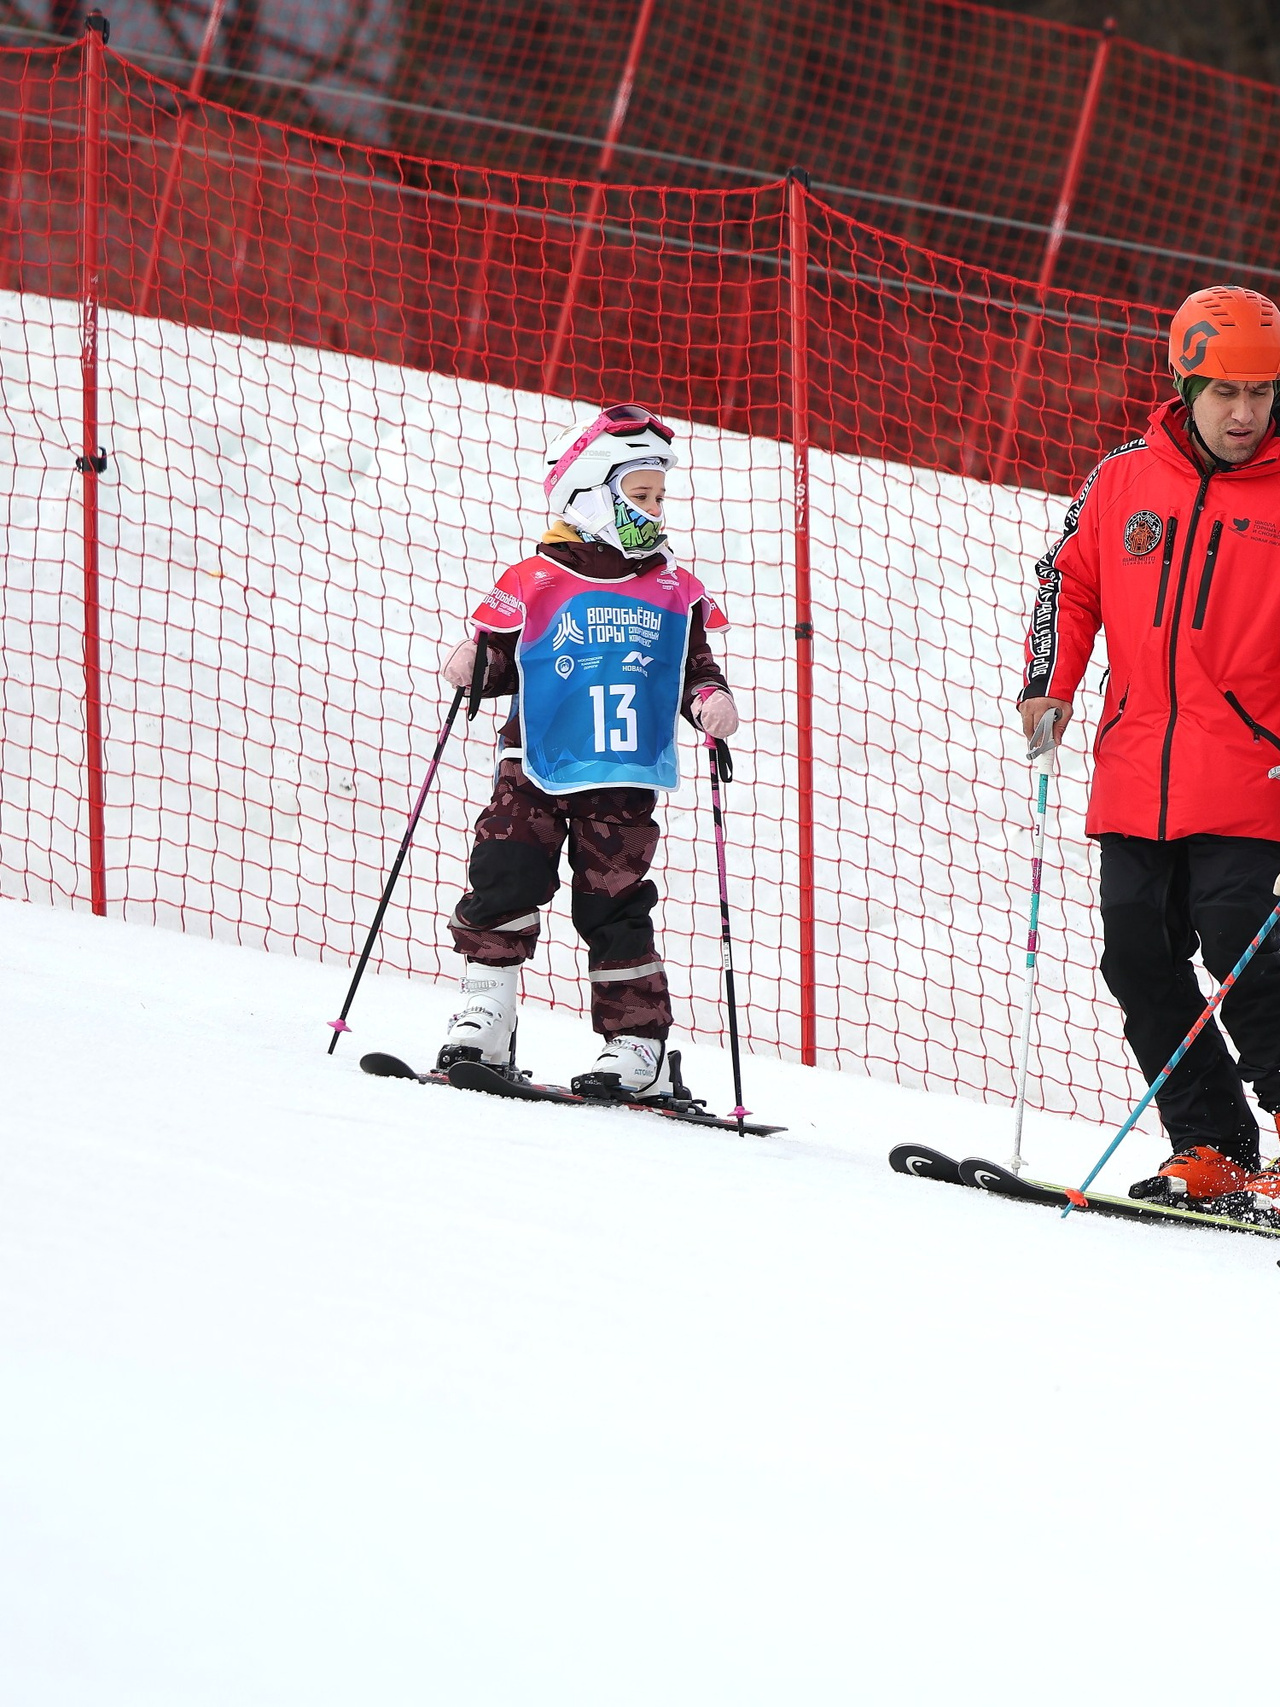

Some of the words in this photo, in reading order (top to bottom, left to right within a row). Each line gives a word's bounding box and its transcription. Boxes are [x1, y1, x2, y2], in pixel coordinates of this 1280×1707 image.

[84, 293, 95, 362] LISKI
[796, 455, 805, 525] LISKI
[587, 606, 662, 631] ВОРОБЬЁВЫ
[588, 625, 625, 644] ГОРЫ
[589, 684, 637, 753] 13
